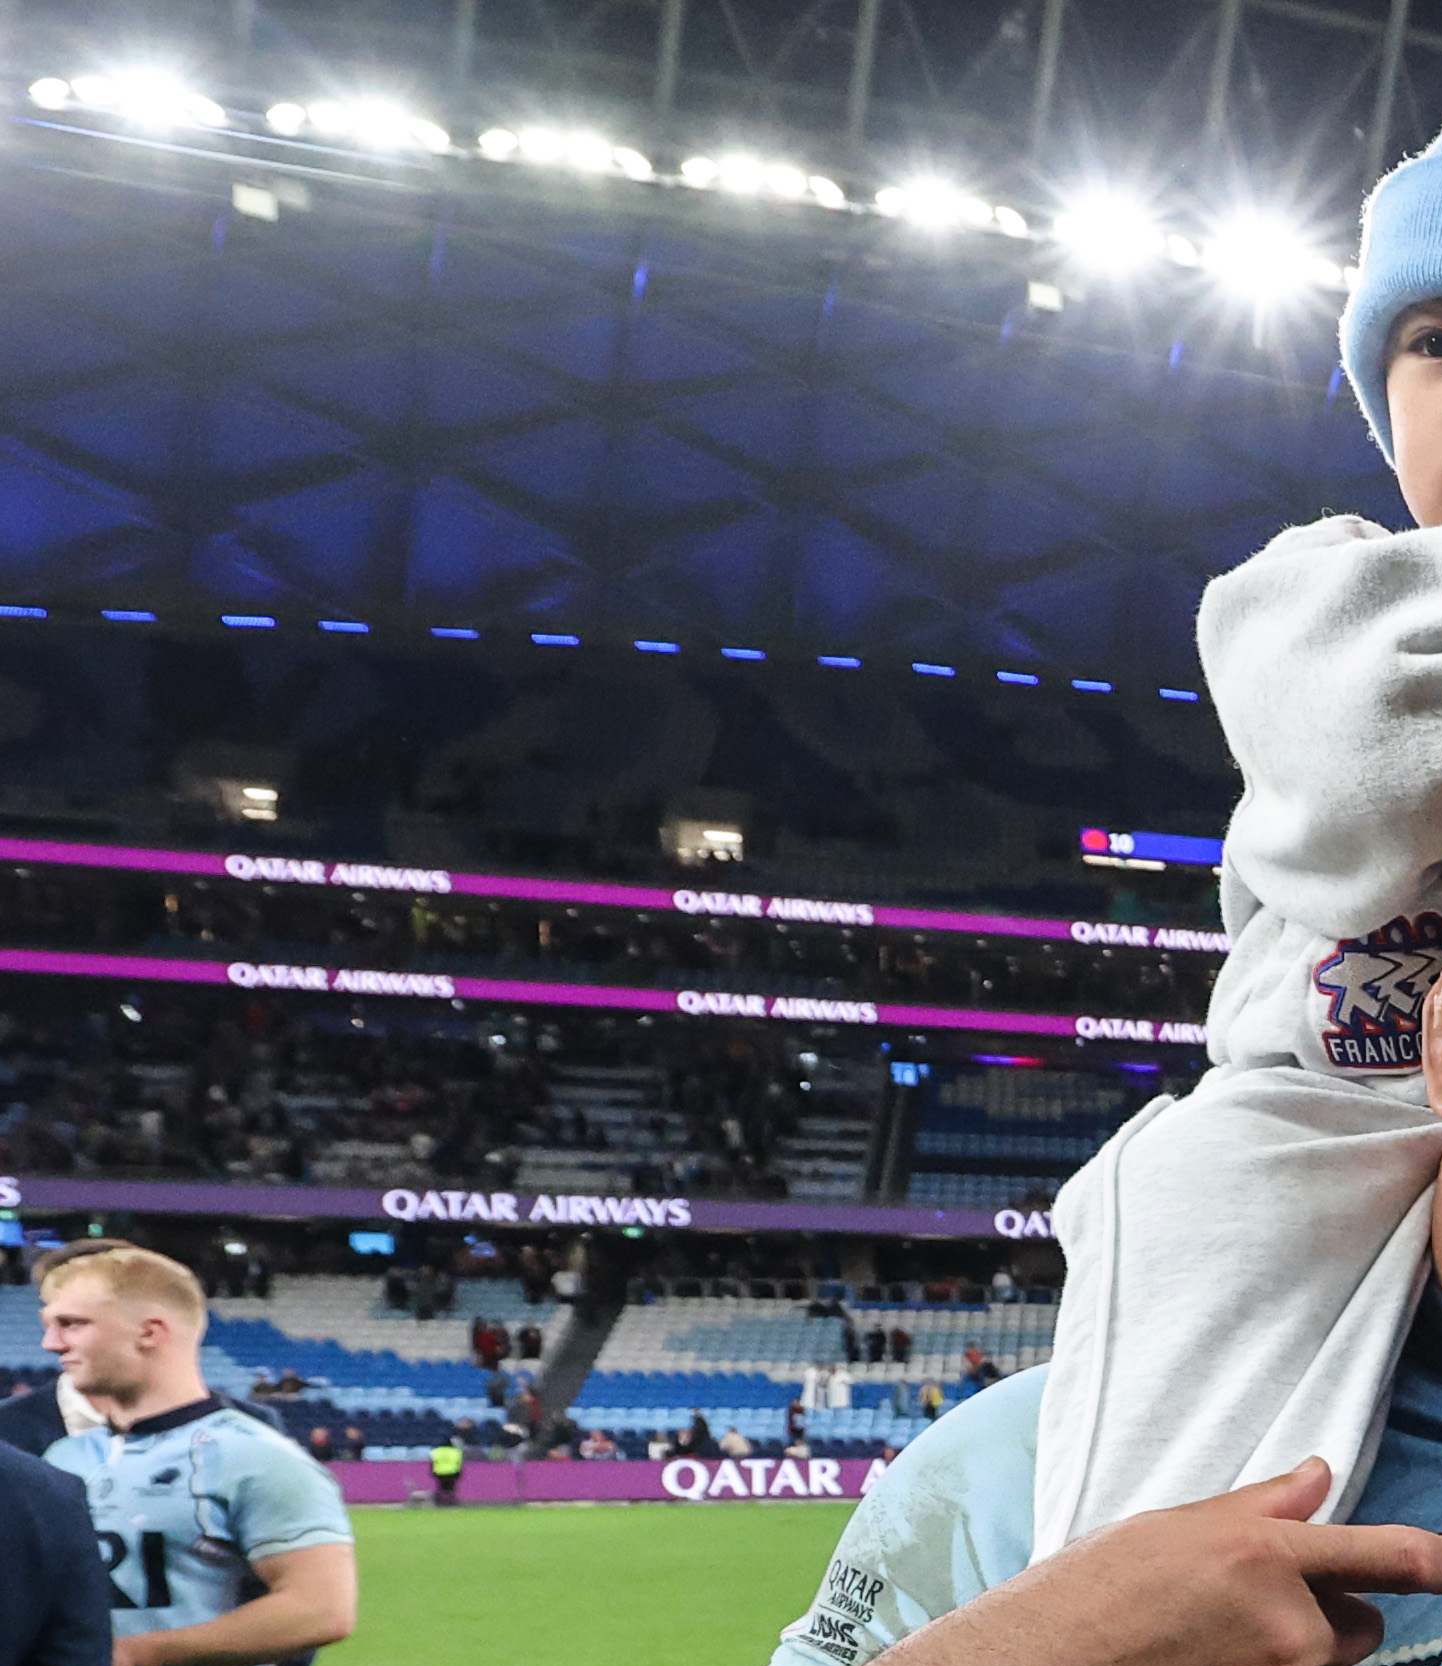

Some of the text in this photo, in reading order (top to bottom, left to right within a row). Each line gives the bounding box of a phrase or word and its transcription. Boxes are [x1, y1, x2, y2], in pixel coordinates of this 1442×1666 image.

[226, 855, 452, 893] QATAR AIRWAYS
[673, 890, 874, 925] QATAR AIRWAYS
[1070, 921, 1233, 953] QATAR AIRWAY
[228, 963, 455, 998] QATAR AIRWAYS
[677, 991, 878, 1024] QATAR AIRWAYS
[1075, 1016, 1154, 1041] QATAR
[383, 1189, 692, 1227] QATAR AIRWAYS
[661, 1457, 843, 1500] QATAR
[828, 1558, 884, 1607] QATAR
[809, 1613, 859, 1649] LIONS
